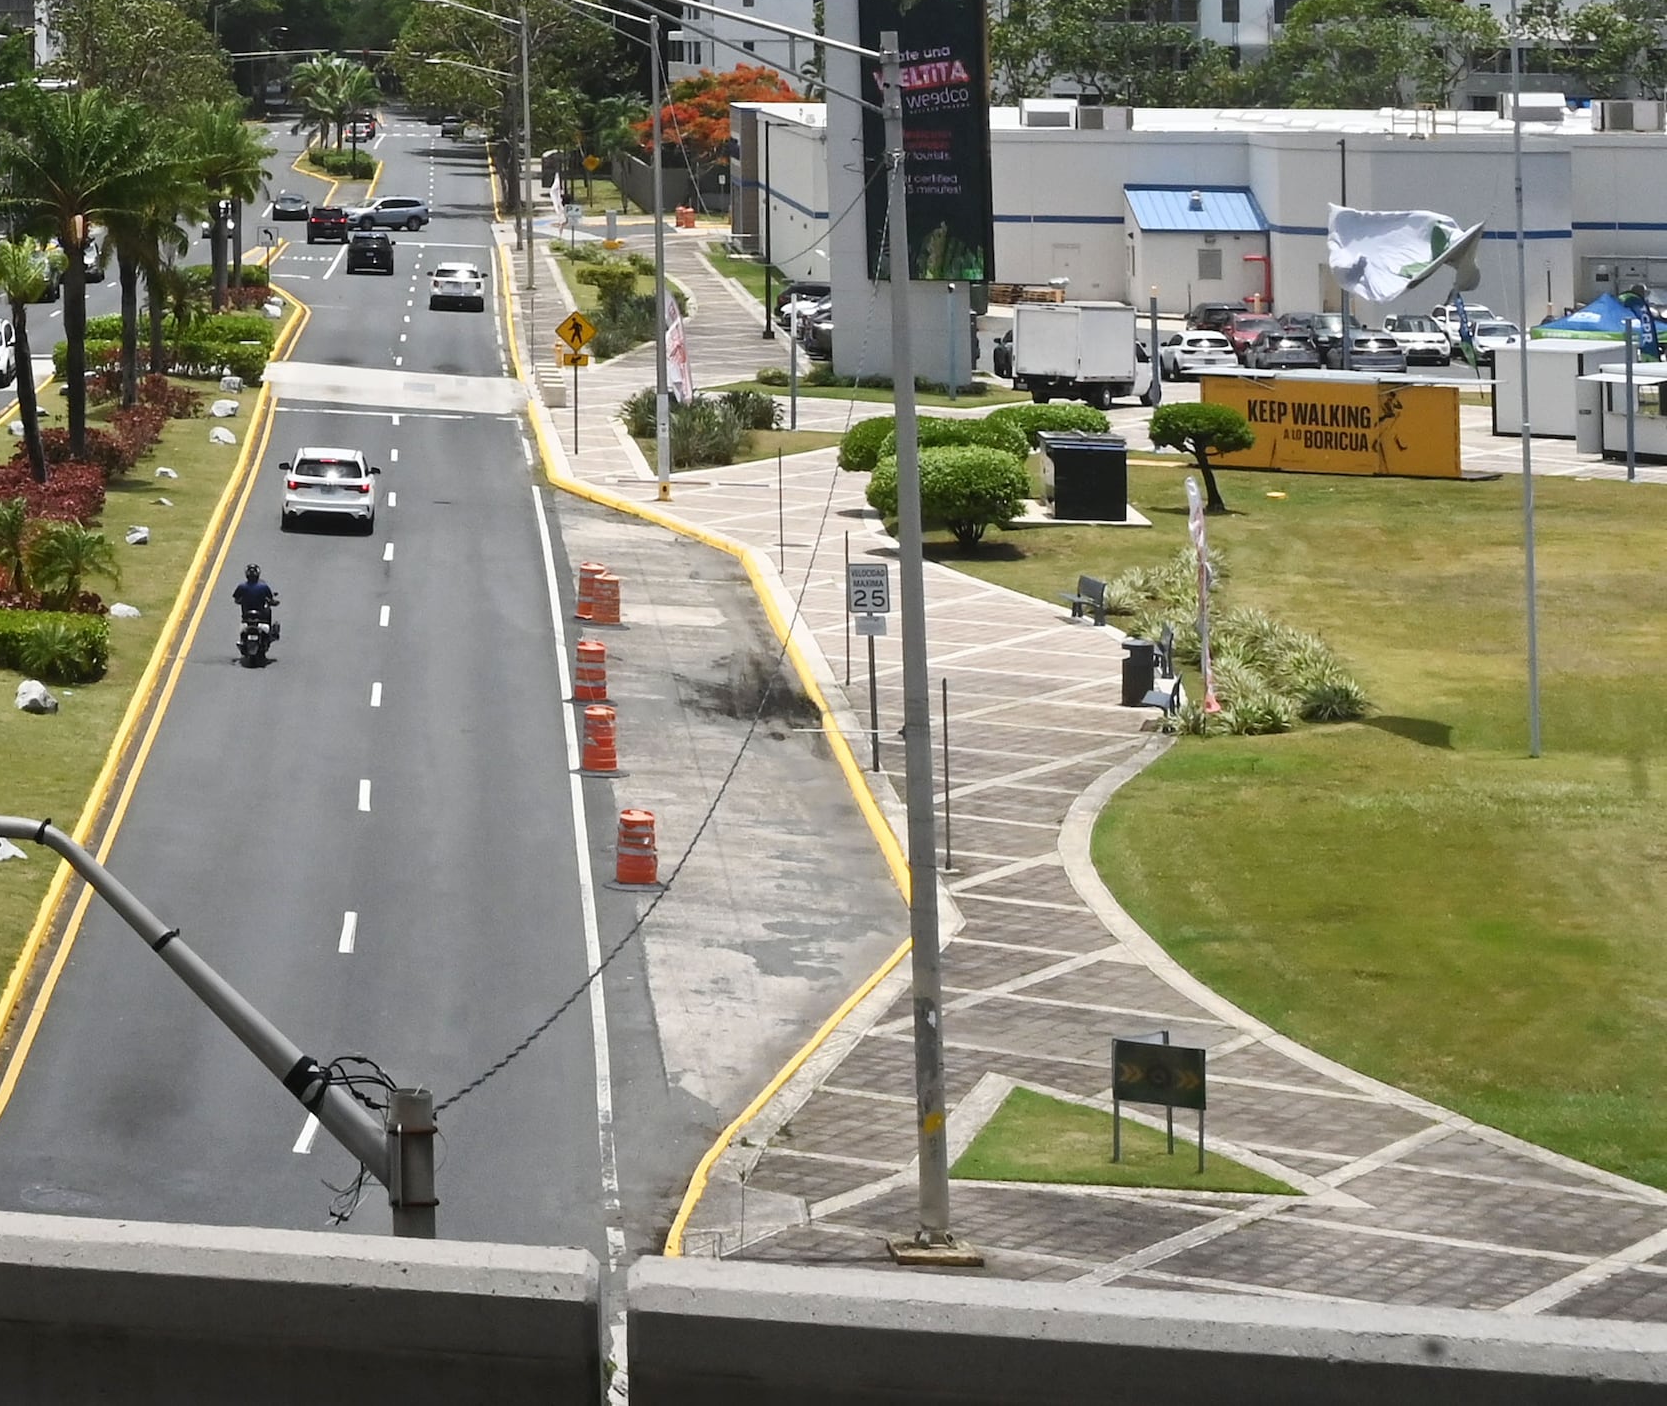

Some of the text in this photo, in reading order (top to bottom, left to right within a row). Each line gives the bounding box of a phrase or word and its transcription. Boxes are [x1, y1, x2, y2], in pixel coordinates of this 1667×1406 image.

[898, 46, 951, 62] ate una
[1248, 399, 1371, 429] KEEP WALKING
[1283, 428, 1369, 452] A LO BORICUA
[854, 590, 885, 607] 25
